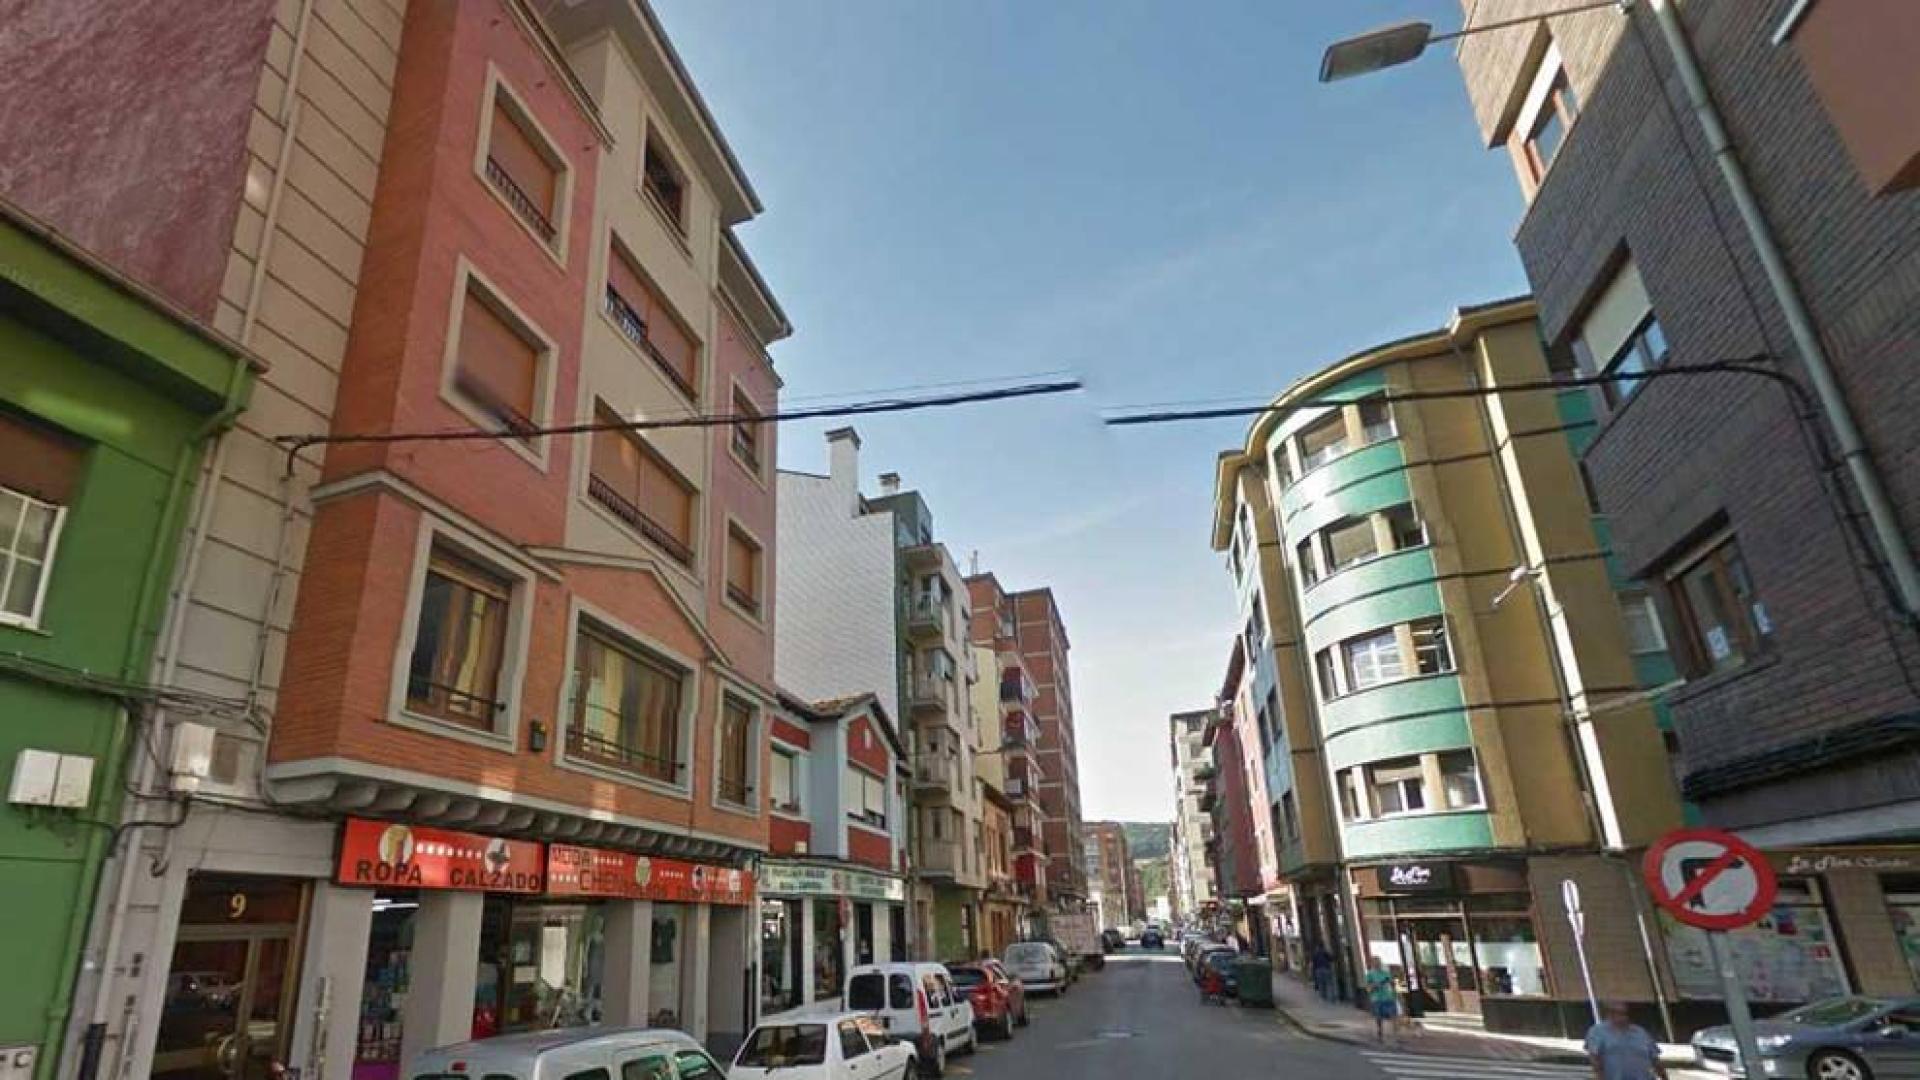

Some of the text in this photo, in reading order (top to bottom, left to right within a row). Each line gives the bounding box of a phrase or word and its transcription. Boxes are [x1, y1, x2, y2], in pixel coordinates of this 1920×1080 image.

[356, 859, 422, 885] ROPA
[450, 868, 540, 890] CALZADO
[230, 893, 247, 918] 9
